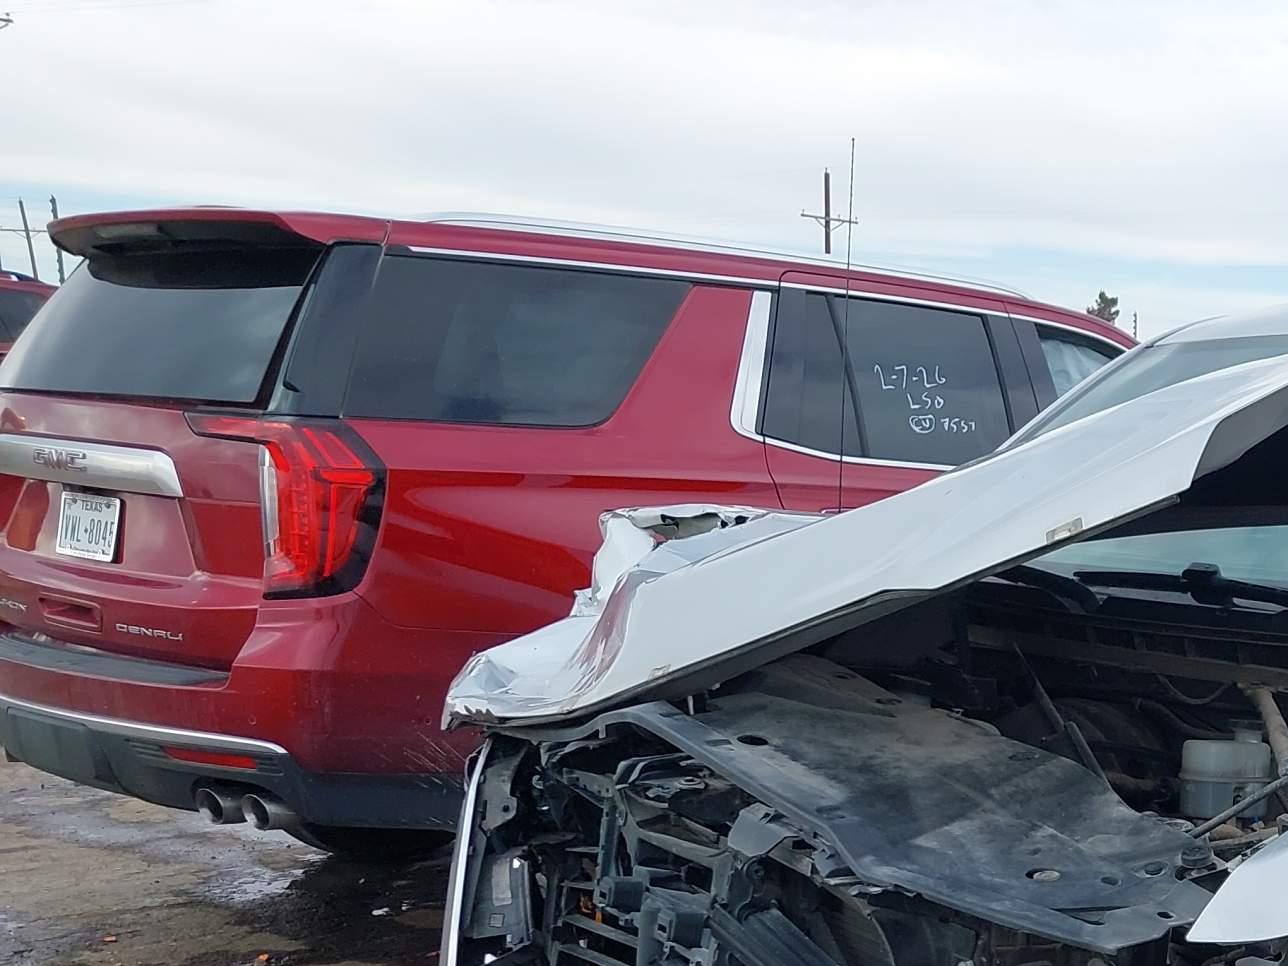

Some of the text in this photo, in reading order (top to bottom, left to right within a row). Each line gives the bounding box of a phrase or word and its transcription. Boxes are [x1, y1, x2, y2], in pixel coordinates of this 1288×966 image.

[874, 364, 946, 390] 2-7-26
[33, 447, 87, 472] GMC
[81, 499, 103, 513] TEXAS
[115, 623, 183, 641] DENALI
